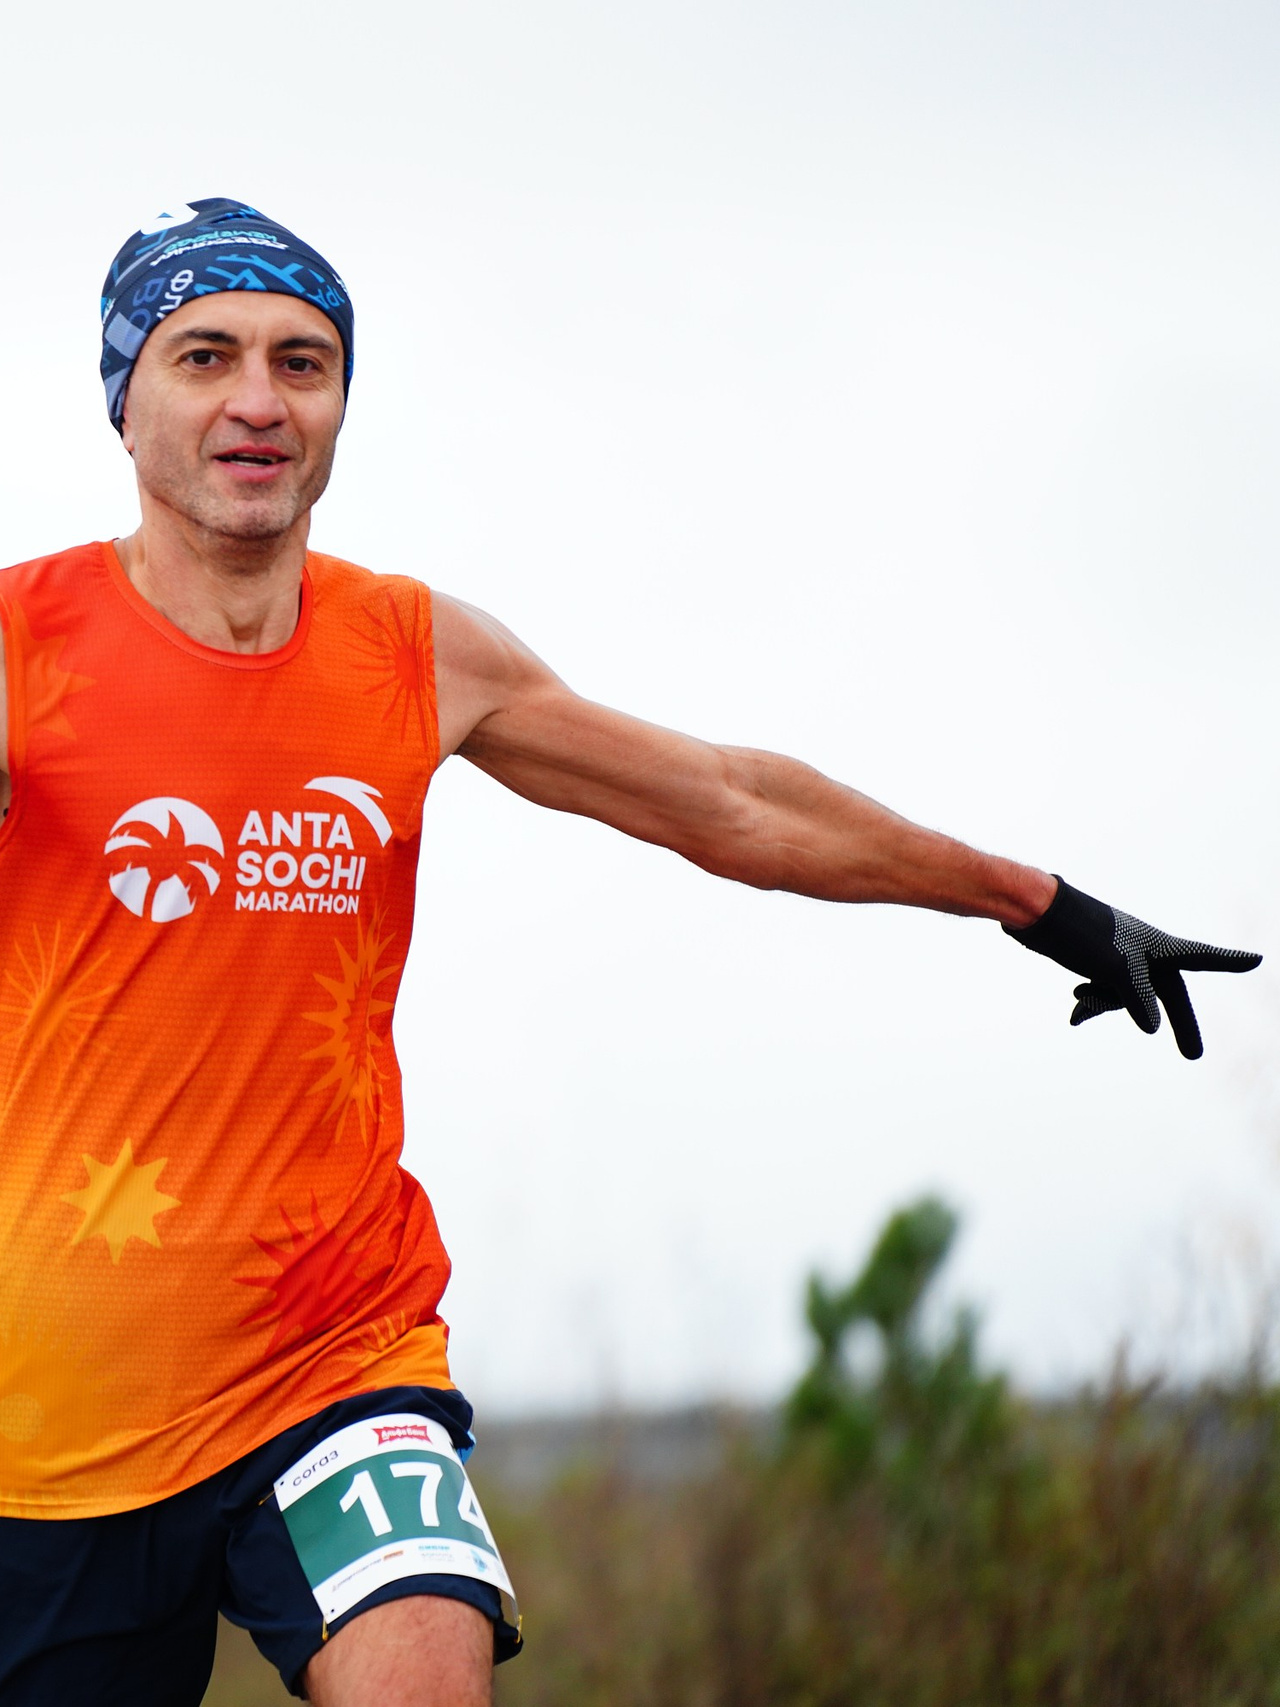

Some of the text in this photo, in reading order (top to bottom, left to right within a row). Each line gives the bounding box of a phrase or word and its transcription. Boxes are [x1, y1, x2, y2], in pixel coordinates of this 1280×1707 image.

[237, 810, 355, 850] ANTA
[235, 850, 367, 891] SOCHI
[234, 890, 360, 915] MARATHON
